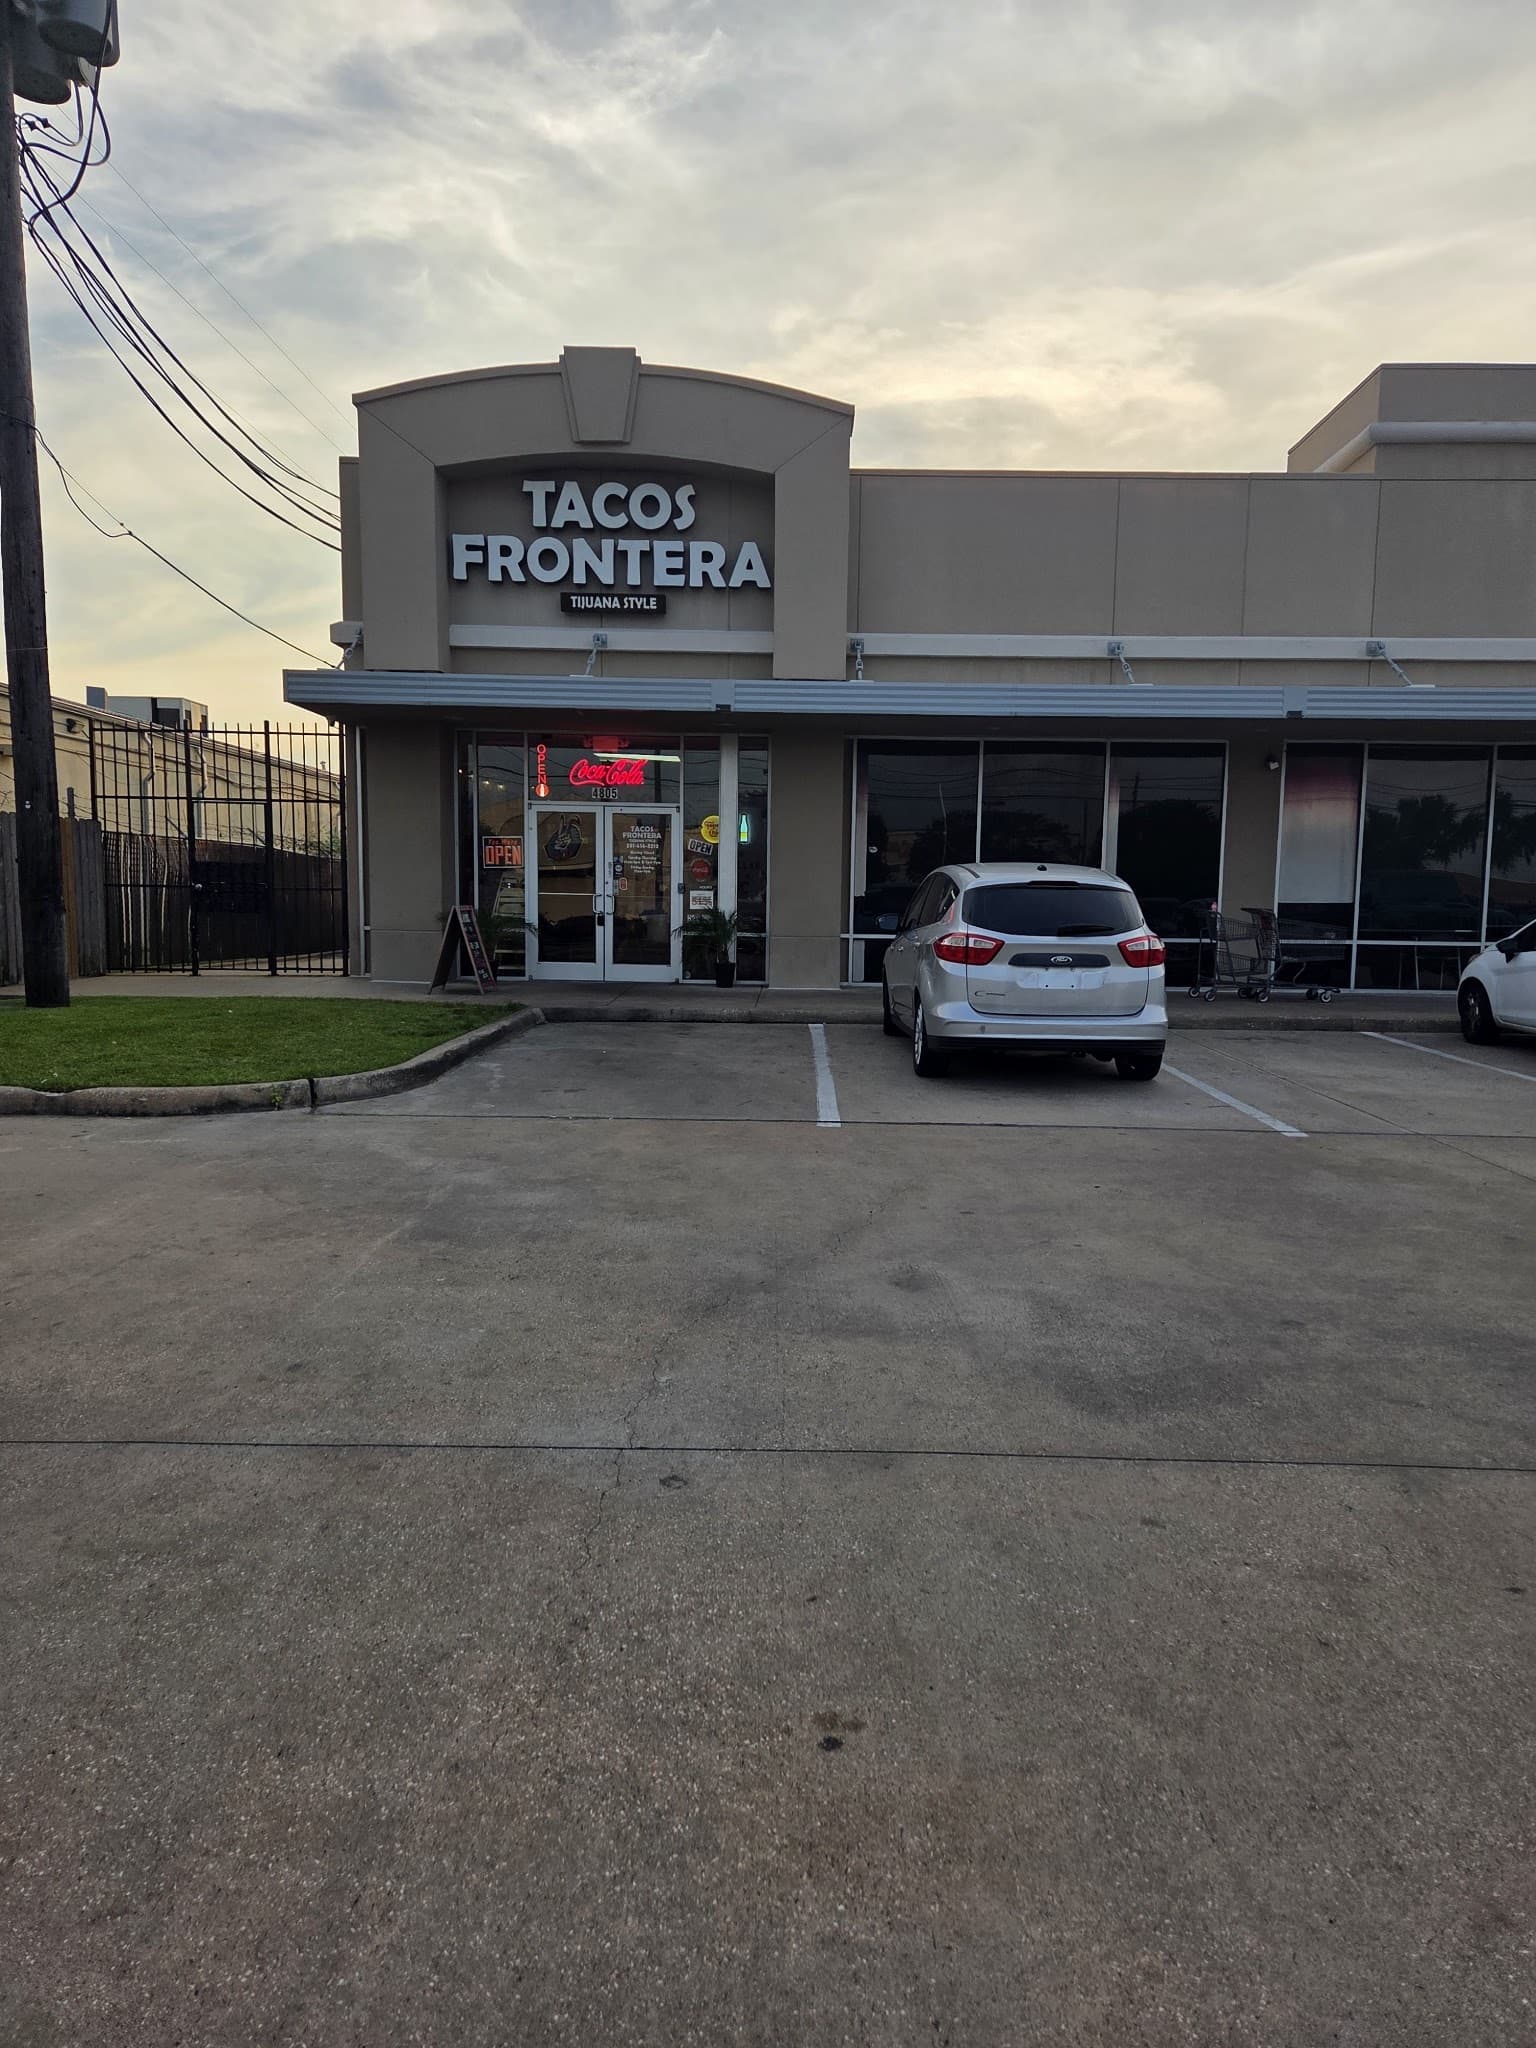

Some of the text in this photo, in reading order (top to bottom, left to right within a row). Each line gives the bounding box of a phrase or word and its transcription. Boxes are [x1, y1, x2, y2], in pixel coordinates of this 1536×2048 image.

[522, 480, 696, 530] TACOS
[452, 534, 771, 588] FRONTERA
[570, 595, 657, 610] TIJUANA STYLE
[536, 744, 547, 784] OPEN
[569, 758, 649, 786] Coca-Cola
[592, 787, 618, 799] 4805
[485, 845, 522, 865] OPEN
[689, 839, 713, 855] OPEN
